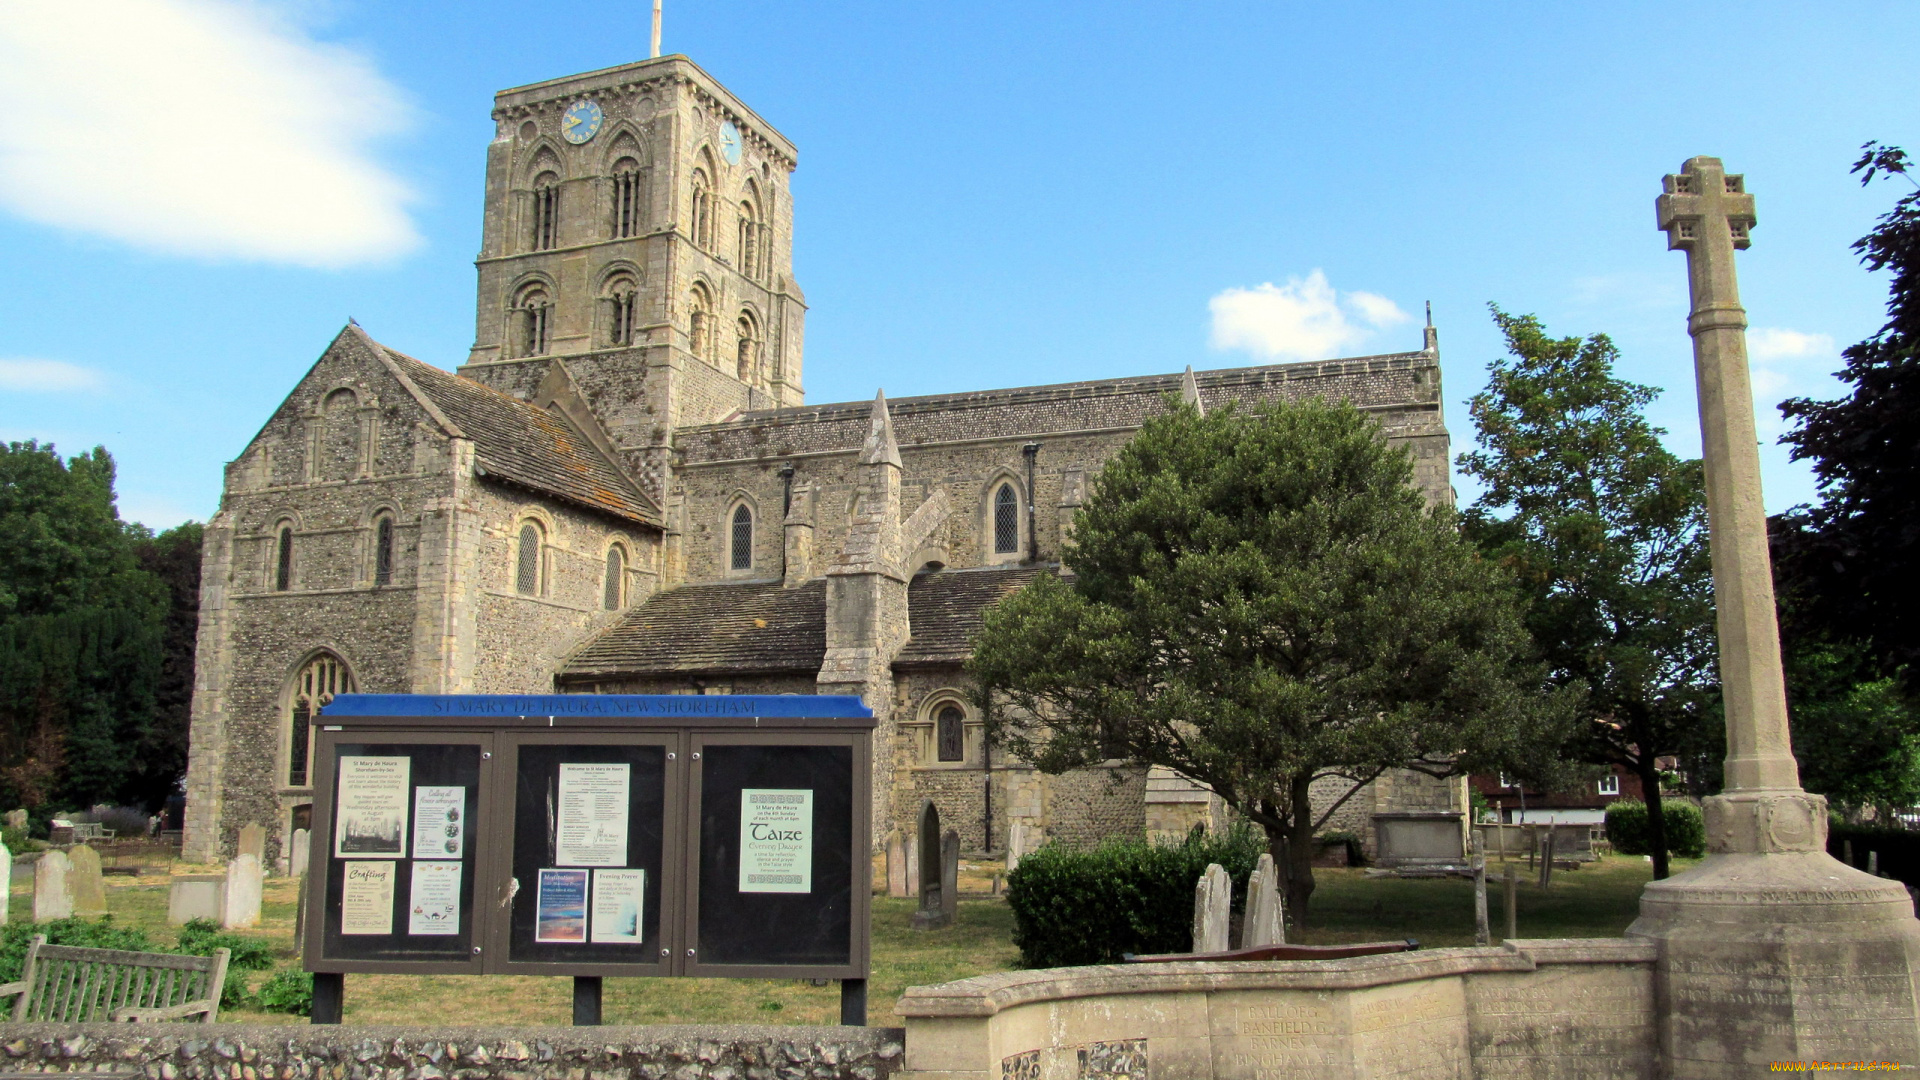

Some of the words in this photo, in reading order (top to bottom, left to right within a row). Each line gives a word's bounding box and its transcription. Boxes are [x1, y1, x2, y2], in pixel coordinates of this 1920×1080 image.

[433, 700, 450, 713] ST
[458, 700, 505, 713] MARY
[514, 700, 536, 713] DE
[613, 700, 649, 713] NEW
[657, 700, 755, 713] SHOREHAM
[749, 822, 804, 840] Taize
[349, 870, 386, 882] Crafting
[1248, 1006, 1283, 1019] BALL
[1242, 1021, 1311, 1034] BANFIELD
[1250, 1037, 1306, 1050] BARNES
